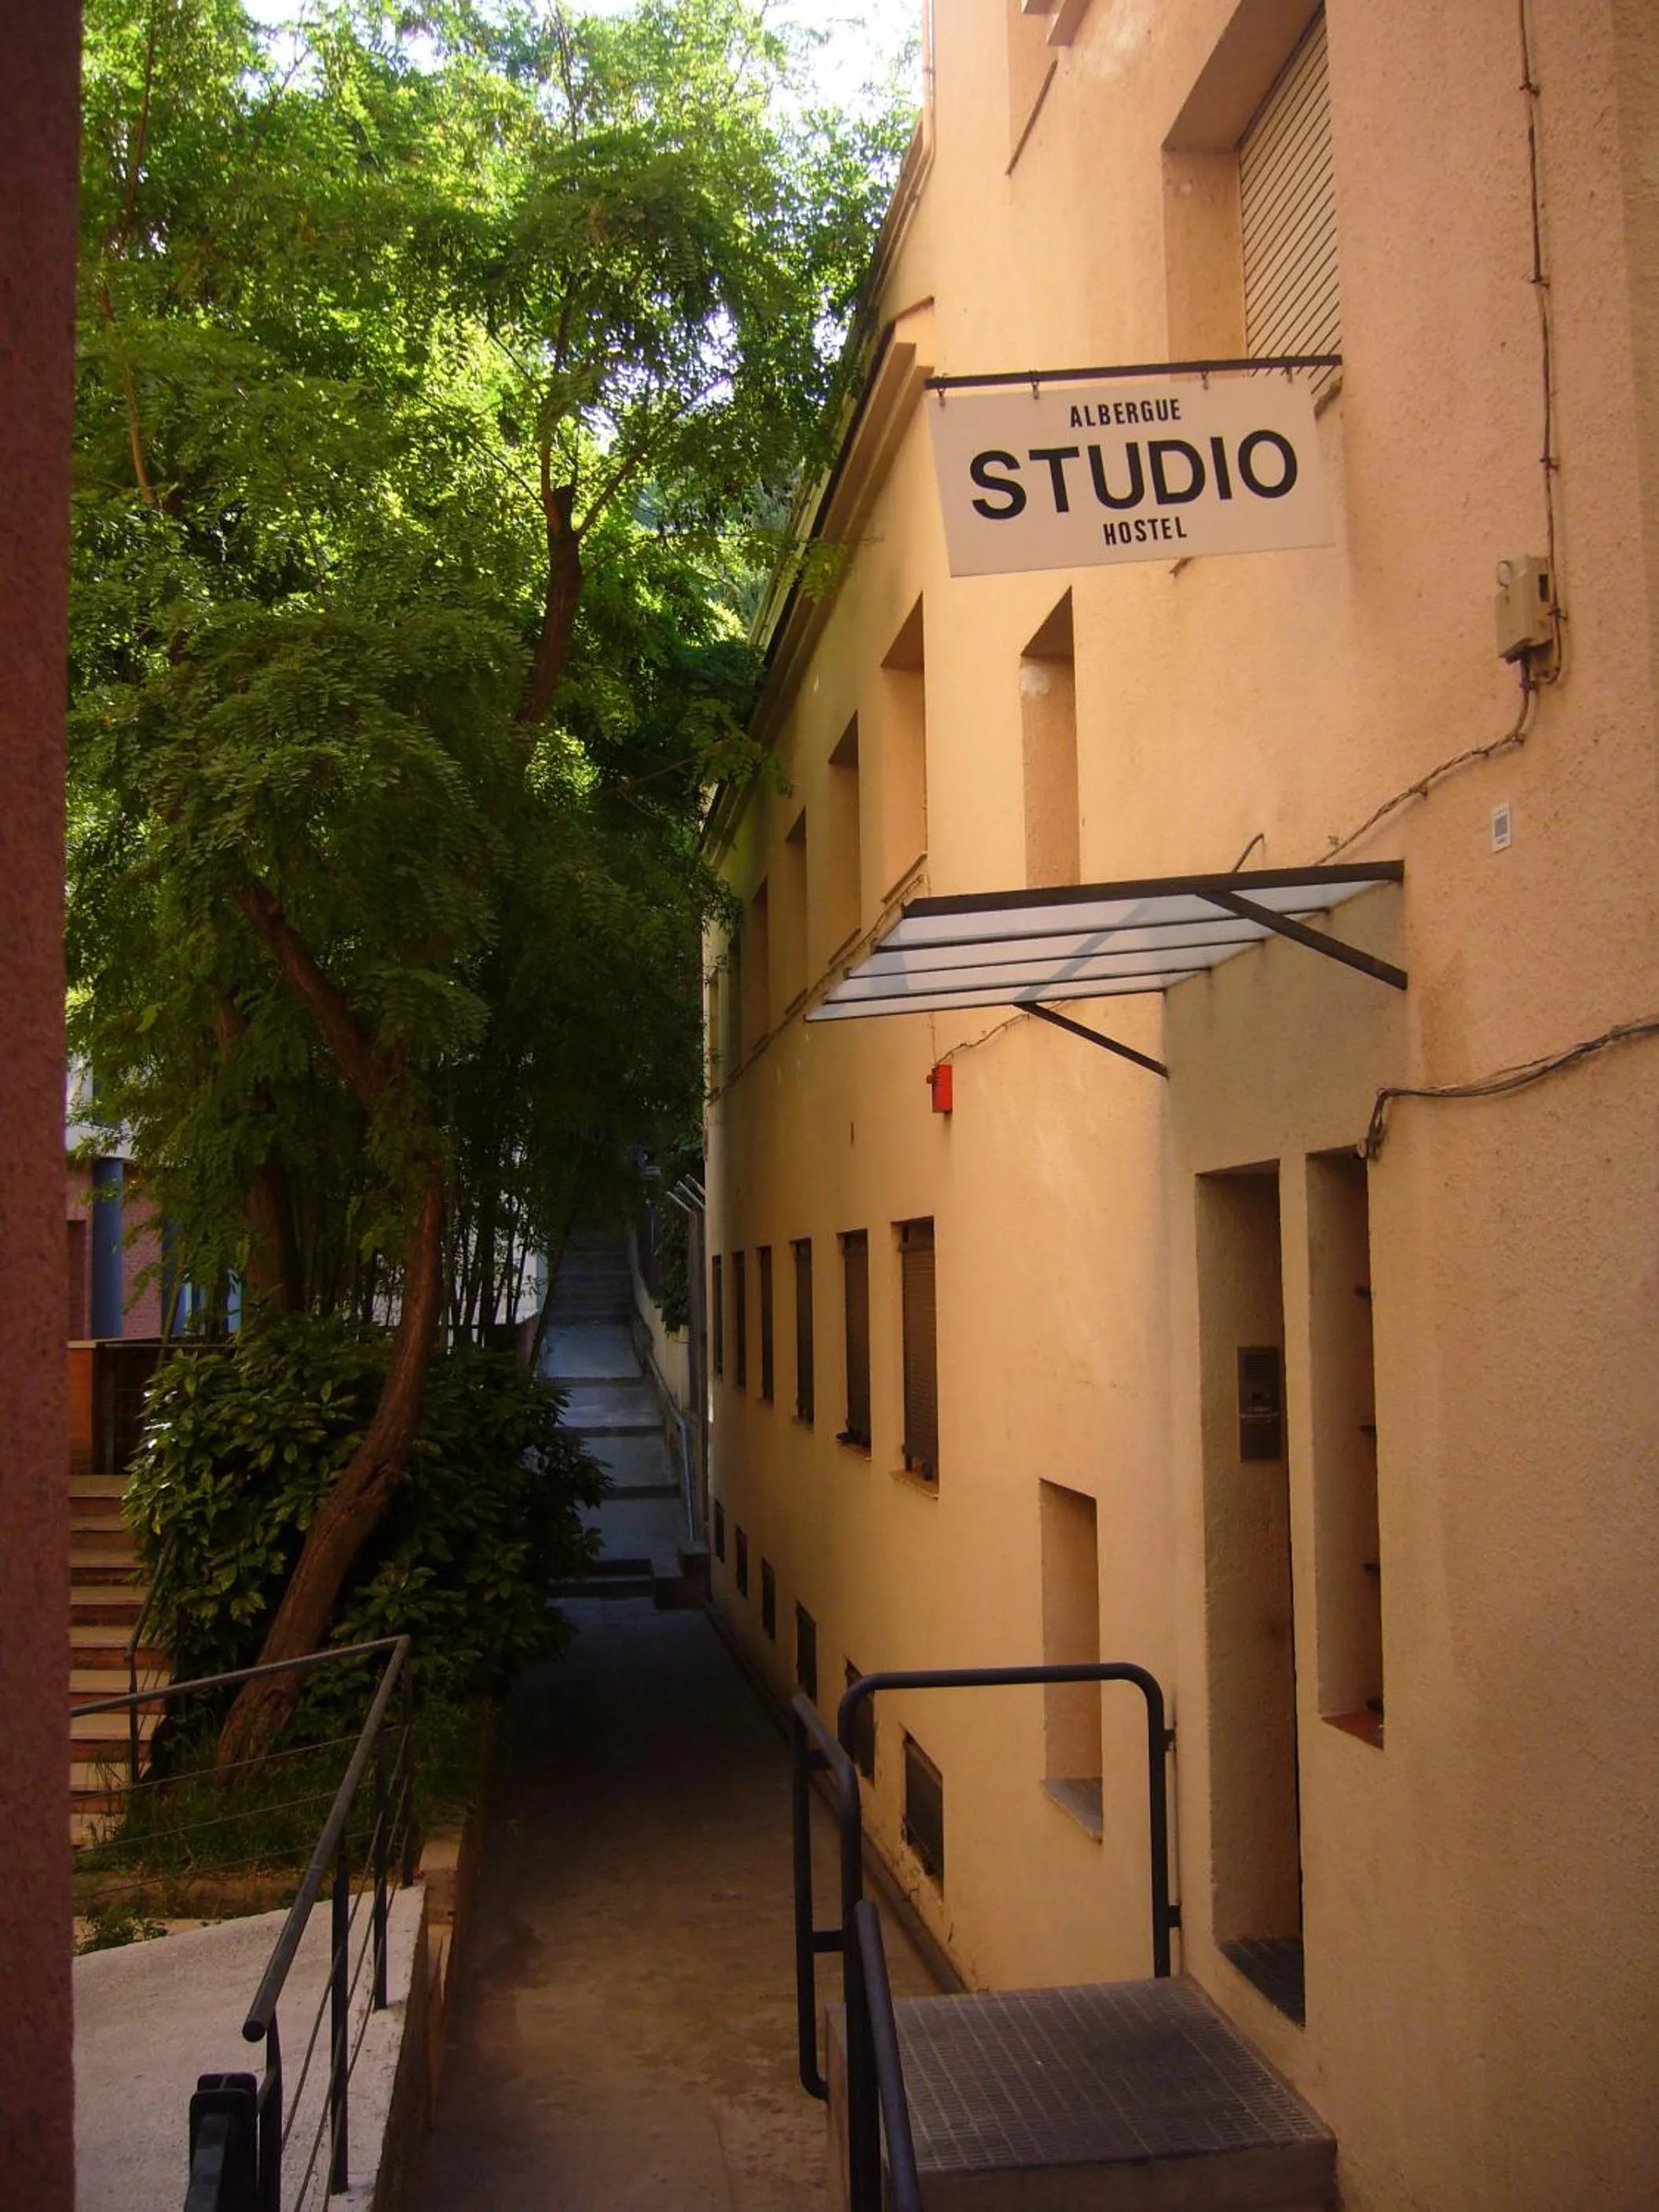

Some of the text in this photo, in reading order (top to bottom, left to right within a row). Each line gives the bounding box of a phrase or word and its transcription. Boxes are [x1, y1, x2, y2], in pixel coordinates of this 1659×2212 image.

[1070, 399, 1181, 427] ALBERGUE
[969, 429, 1298, 520] STUDIO
[1103, 516, 1187, 546] HOSTEL
